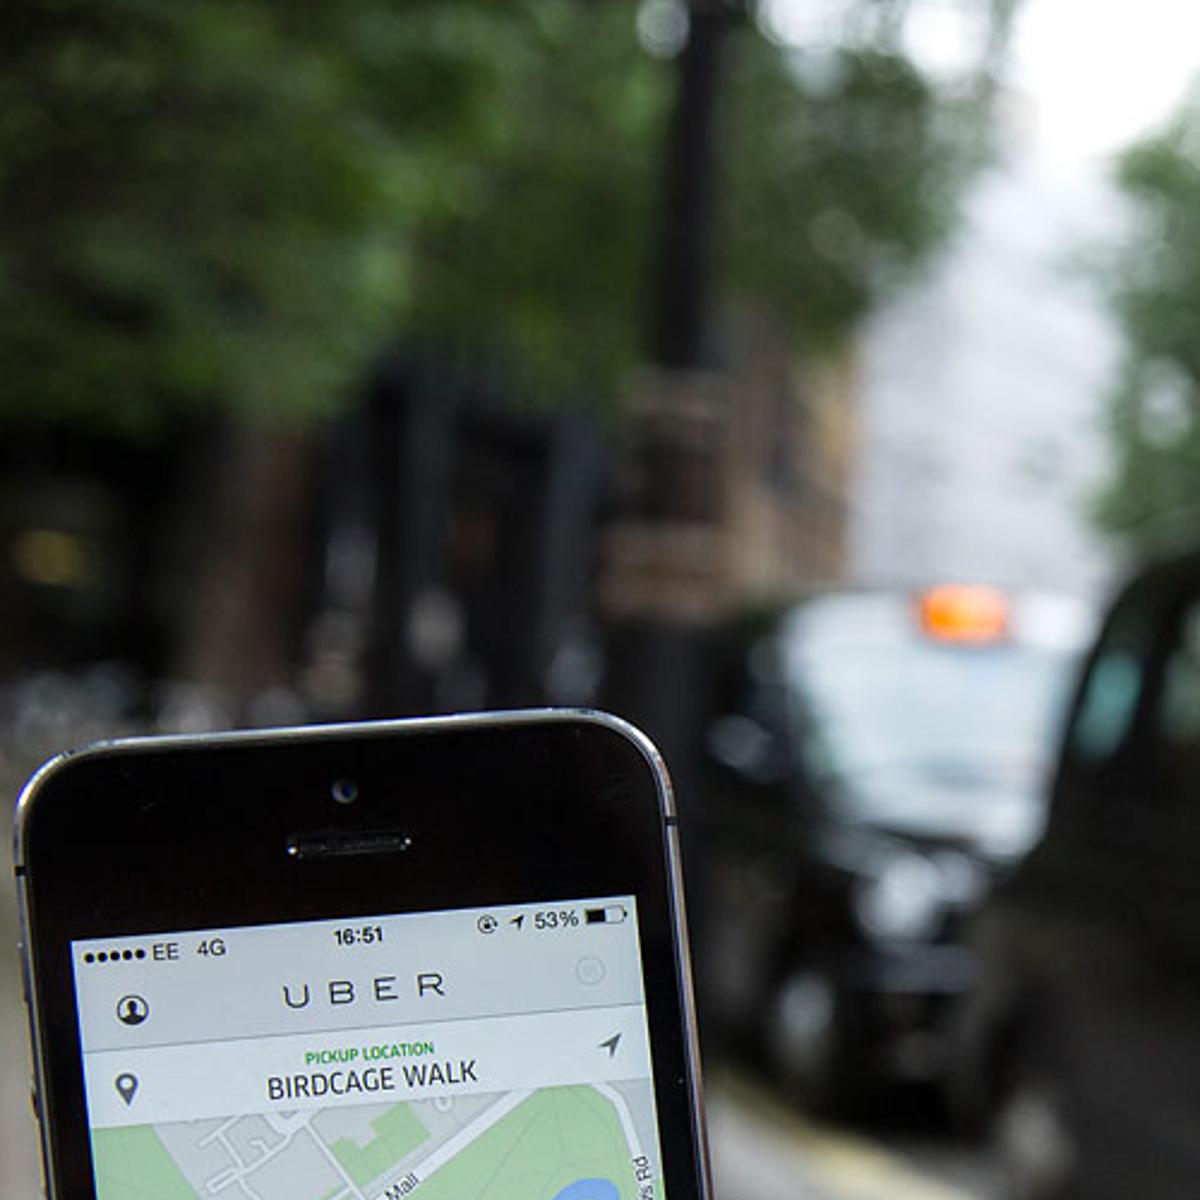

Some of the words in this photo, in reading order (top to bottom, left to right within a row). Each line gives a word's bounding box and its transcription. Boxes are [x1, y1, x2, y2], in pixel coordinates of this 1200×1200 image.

[534, 909, 579, 930] 53%
[334, 927, 383, 946] 16:51
[152, 943, 179, 961] EE
[196, 939, 226, 957] 4G
[283, 973, 445, 1009] UBER
[305, 1049, 358, 1065] PICKUP
[363, 1041, 435, 1061] LOCATION
[268, 1067, 394, 1100] BIRDCAGE
[403, 1060, 478, 1088] WALK
[632, 1155, 653, 1180] Rd
